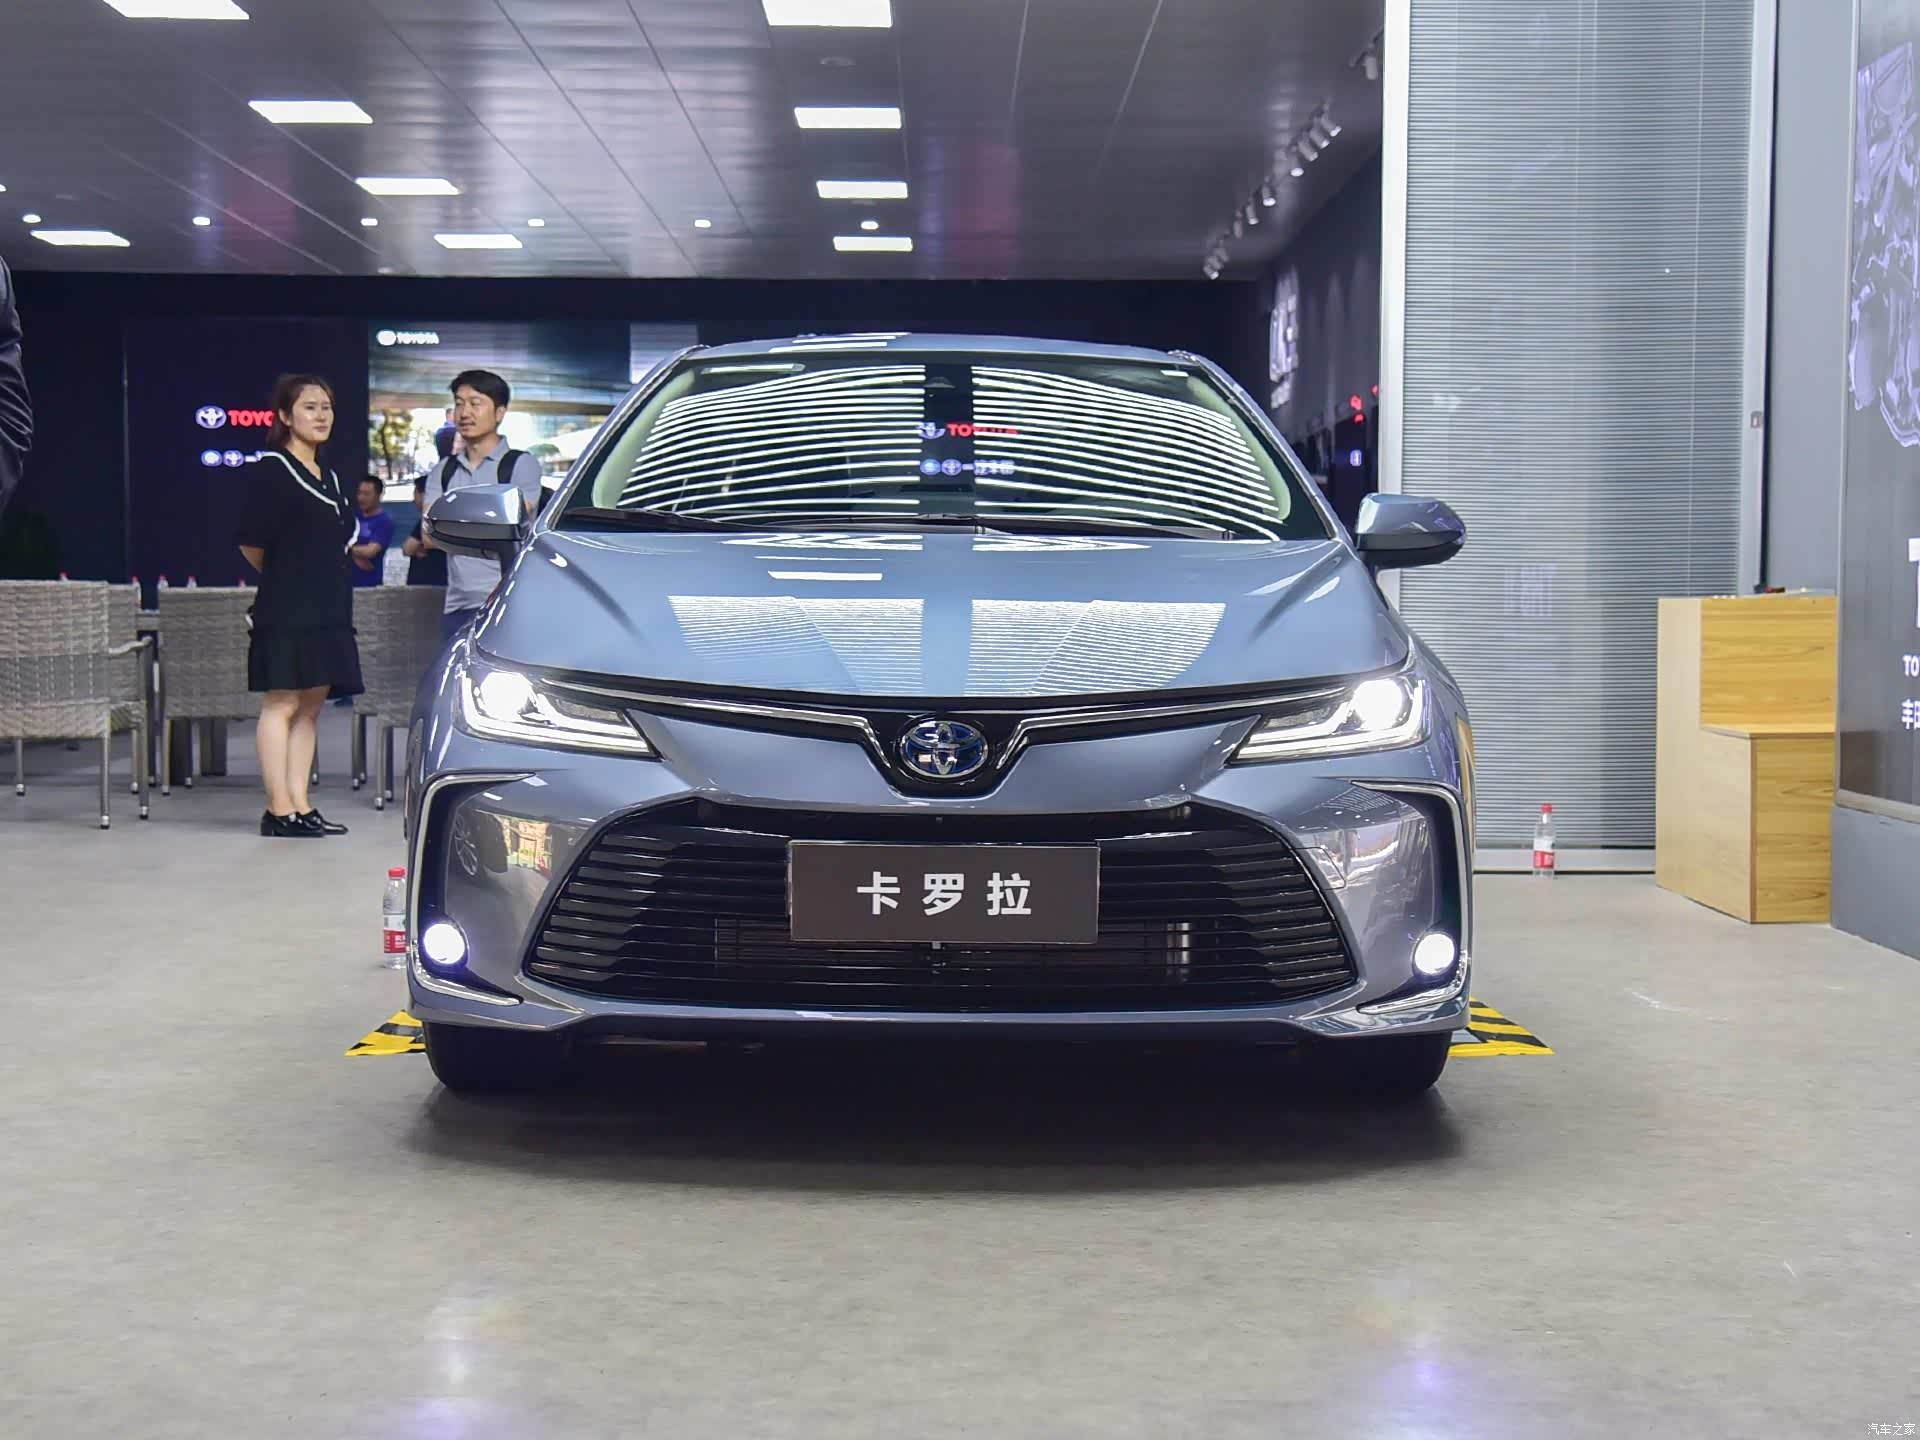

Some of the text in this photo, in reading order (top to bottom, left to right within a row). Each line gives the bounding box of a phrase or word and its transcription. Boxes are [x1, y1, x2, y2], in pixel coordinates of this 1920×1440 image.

[396, 331, 440, 345] TOYOTA
[227, 410, 274, 427] TOYO
[856, 871, 1032, 916] 卡罗拉
